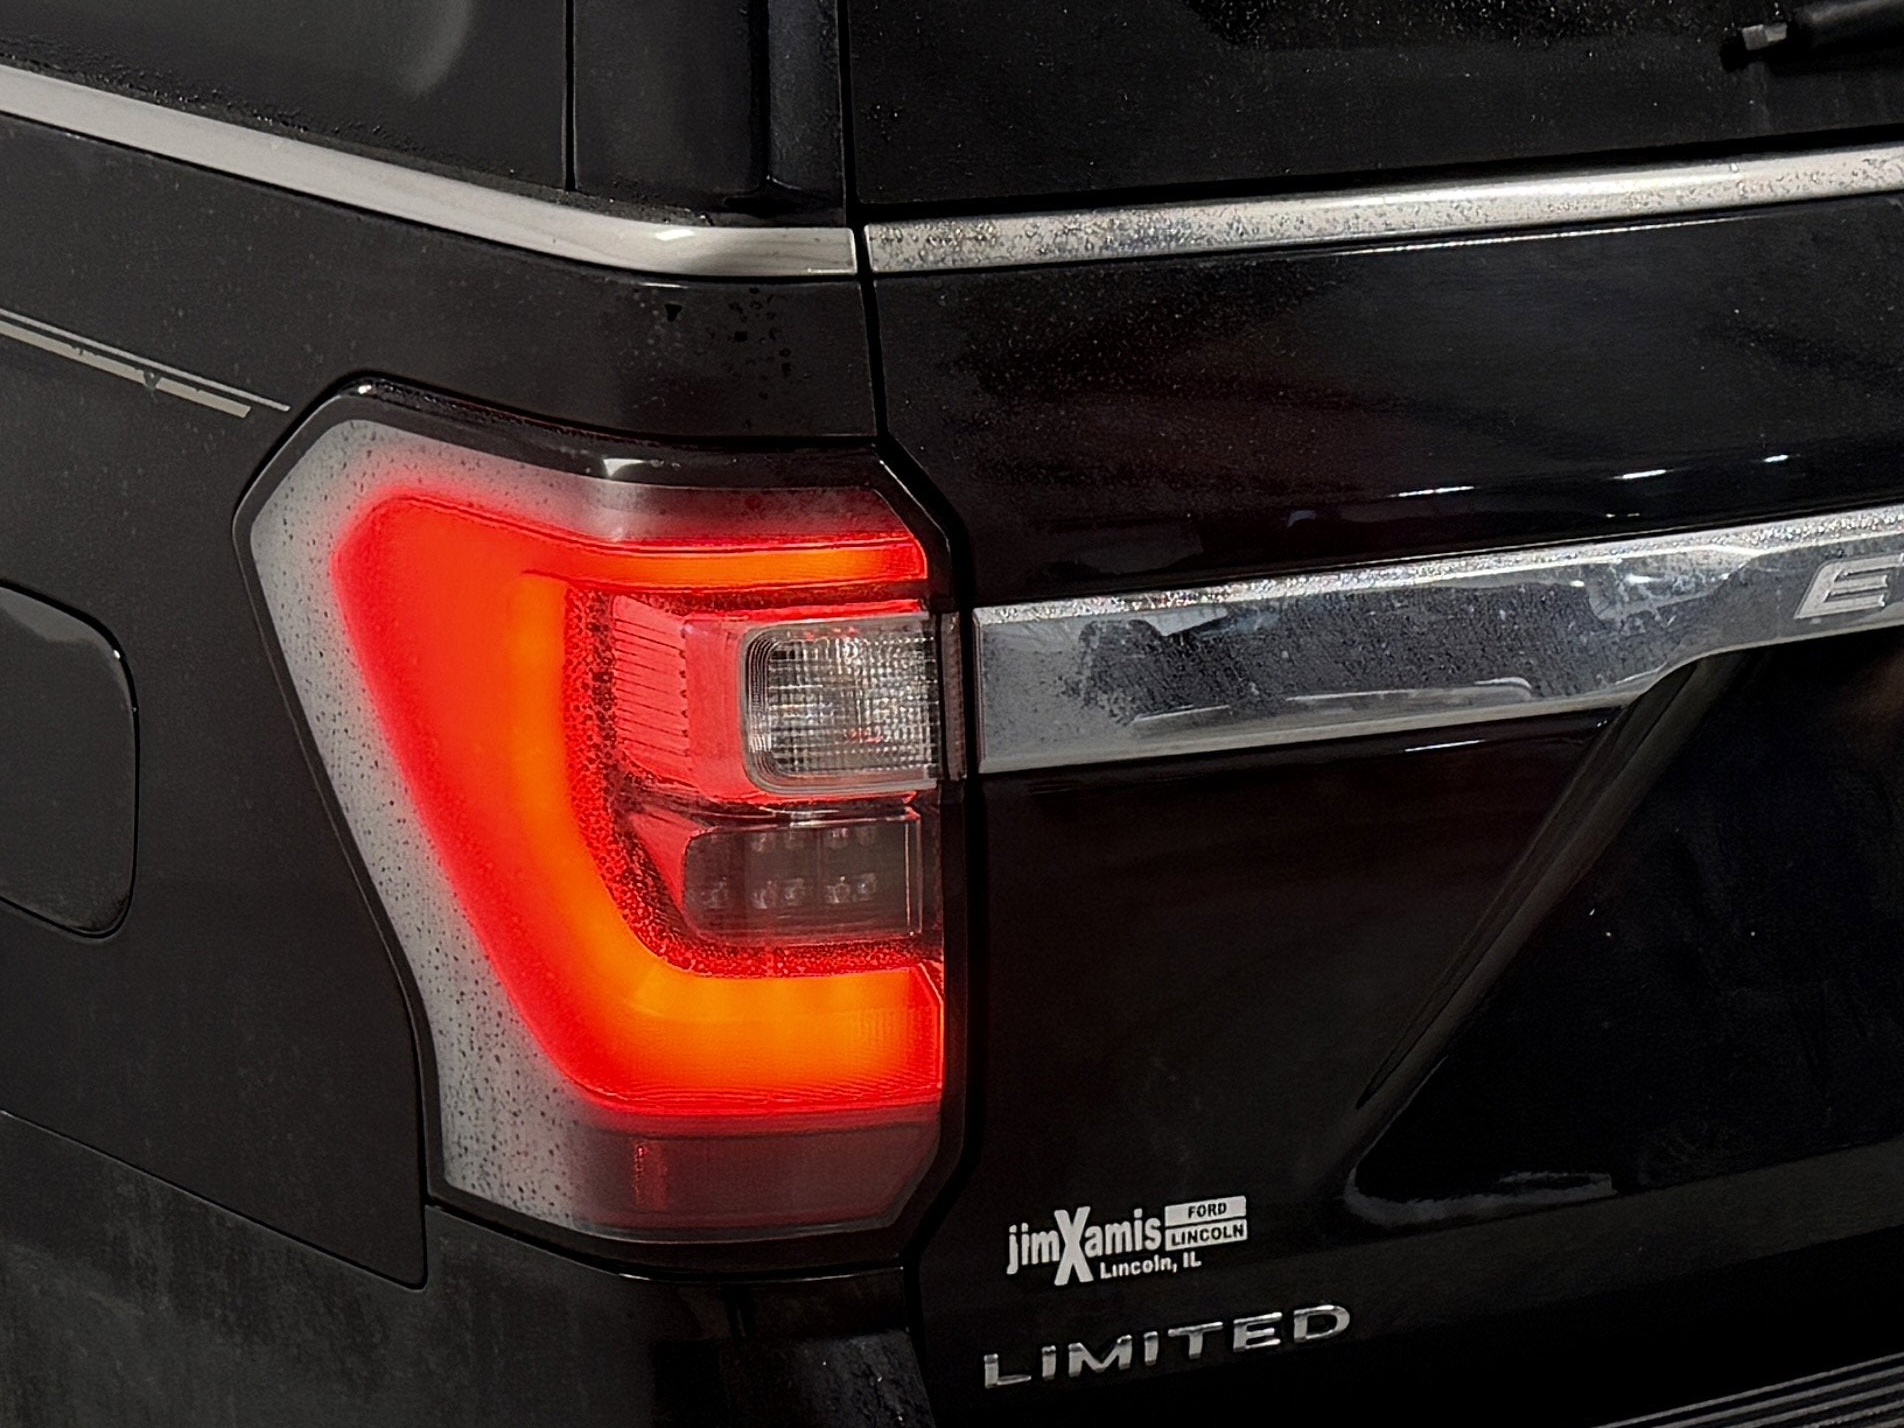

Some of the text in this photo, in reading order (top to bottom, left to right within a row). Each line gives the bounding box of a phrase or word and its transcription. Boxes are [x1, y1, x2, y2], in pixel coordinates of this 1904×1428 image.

[1187, 1202, 1228, 1220] FORD
[1170, 1222, 1245, 1247] LINCOLN
[1099, 1250, 1202, 1280] Lincoln, IL
[983, 1303, 1351, 1389] LIMITED
